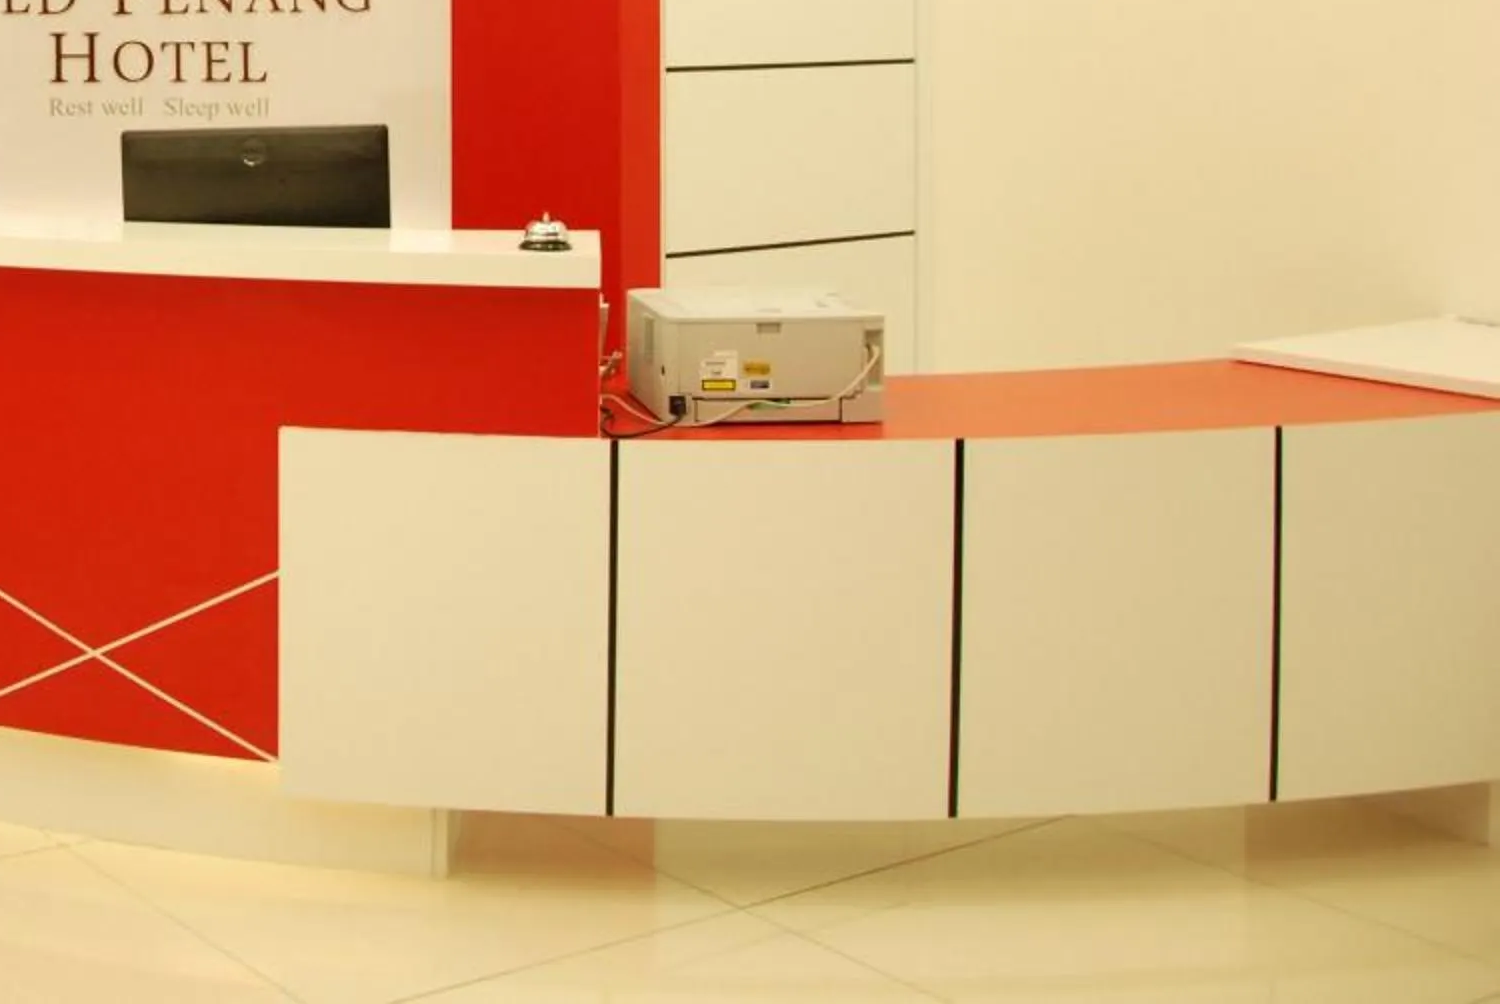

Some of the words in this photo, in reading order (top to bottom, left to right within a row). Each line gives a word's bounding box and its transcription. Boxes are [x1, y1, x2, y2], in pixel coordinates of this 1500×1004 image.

[49, 32, 268, 83] HOTEL
[49, 97, 93, 117] Rest
[101, 96, 144, 117] well
[163, 96, 220, 121] Sleep
[226, 96, 270, 117] well
